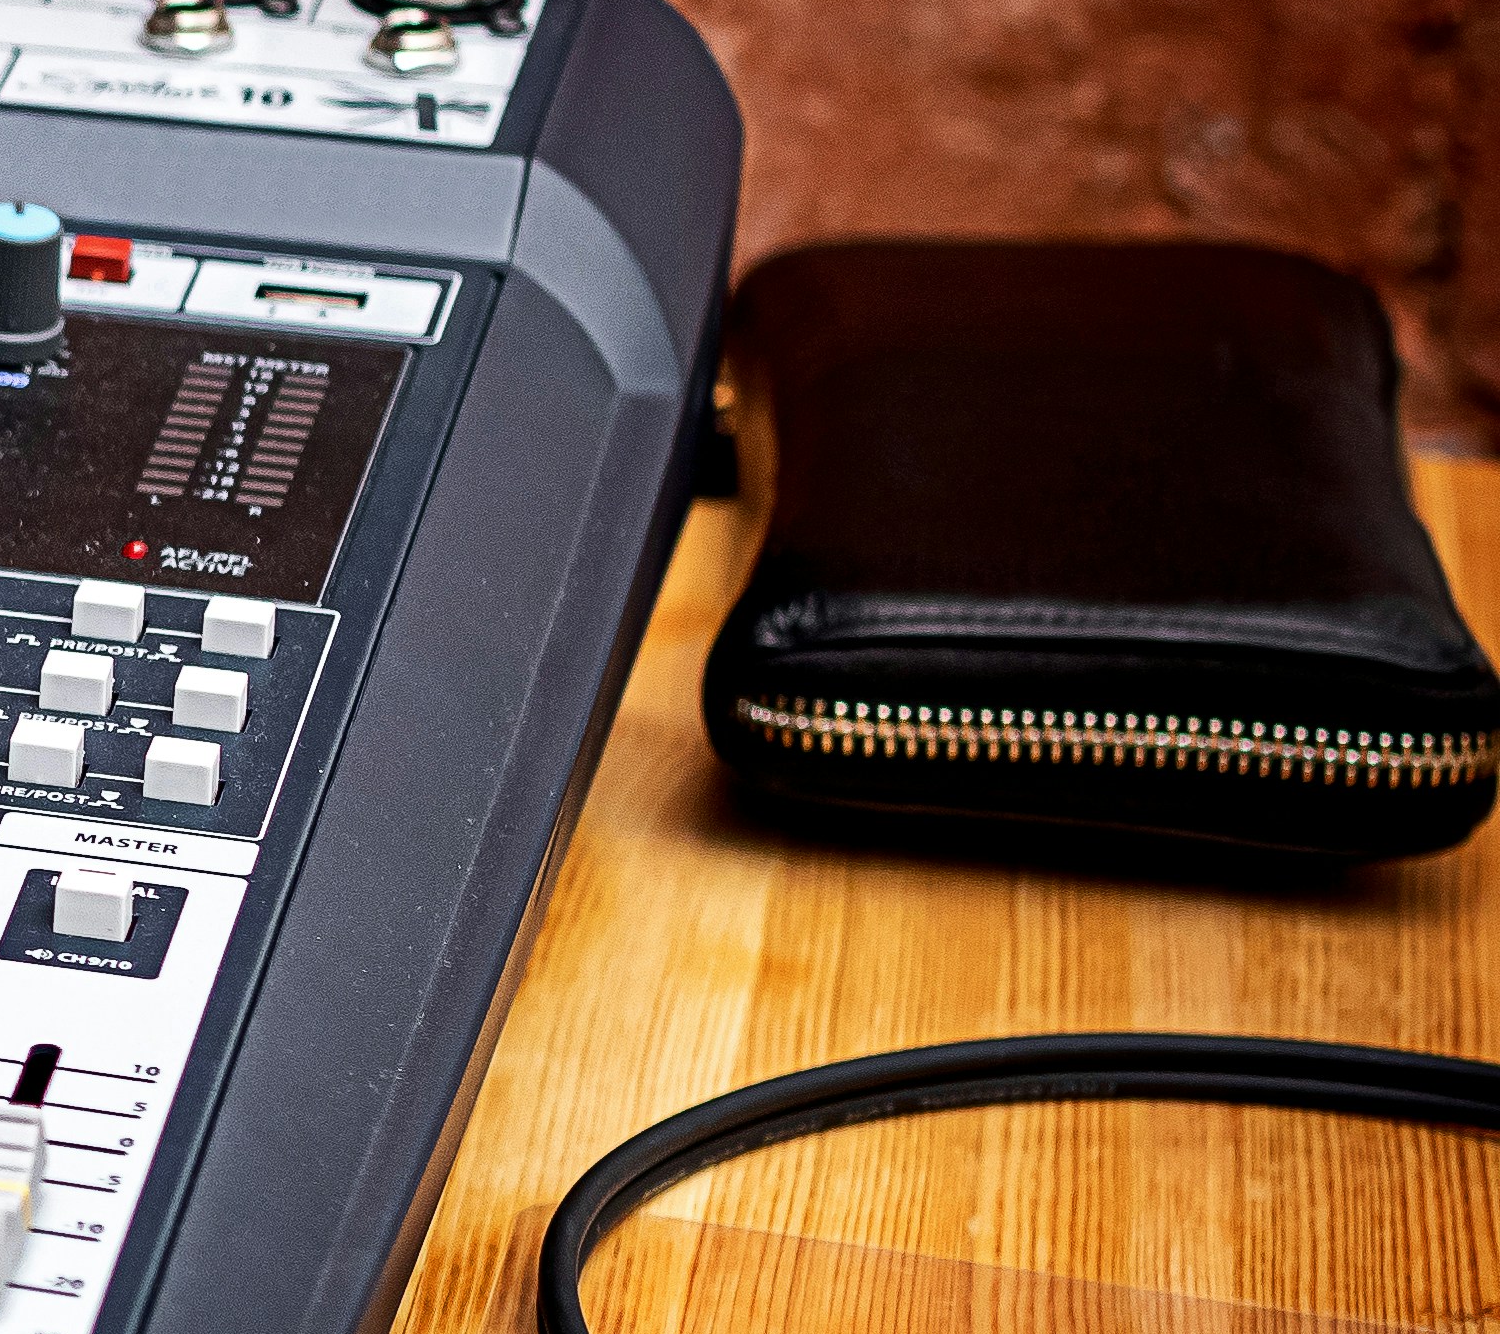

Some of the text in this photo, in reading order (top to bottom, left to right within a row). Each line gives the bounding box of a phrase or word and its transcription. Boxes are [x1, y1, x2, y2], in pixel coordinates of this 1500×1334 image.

[49, 638, 150, 660] PRE/POST
[74, 832, 179, 855] MASTER
[133, 1064, 161, 1077] 10
[64, 1221, 105, 1234] -10
